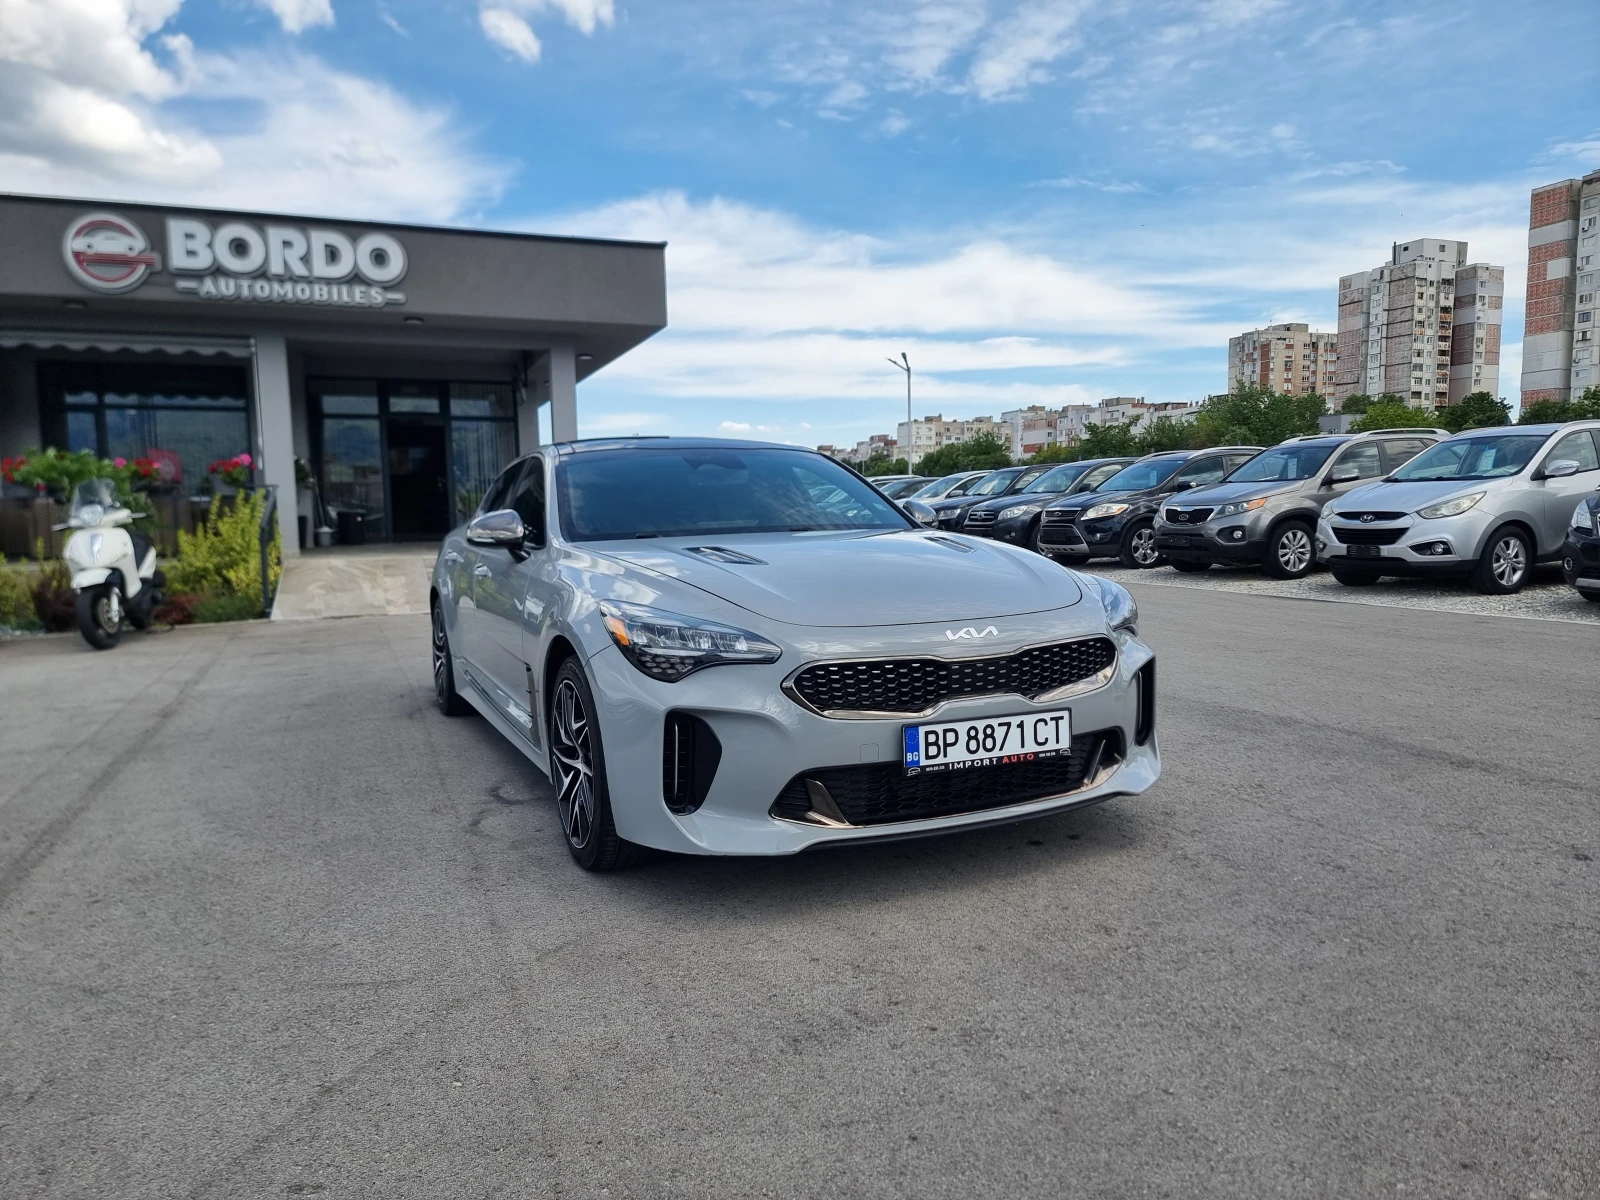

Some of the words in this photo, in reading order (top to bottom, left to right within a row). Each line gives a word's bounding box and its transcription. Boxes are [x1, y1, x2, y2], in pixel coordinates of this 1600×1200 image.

[166, 217, 405, 283] BORDO
[201, 279, 383, 304] AUTOMOBILES
[924, 728, 959, 760] BP
[965, 720, 1026, 755] 8871
[1033, 715, 1064, 746] CT
[906, 752, 919, 762] BG
[949, 757, 998, 770] IMPORT
[1002, 753, 1035, 764] AUTO
